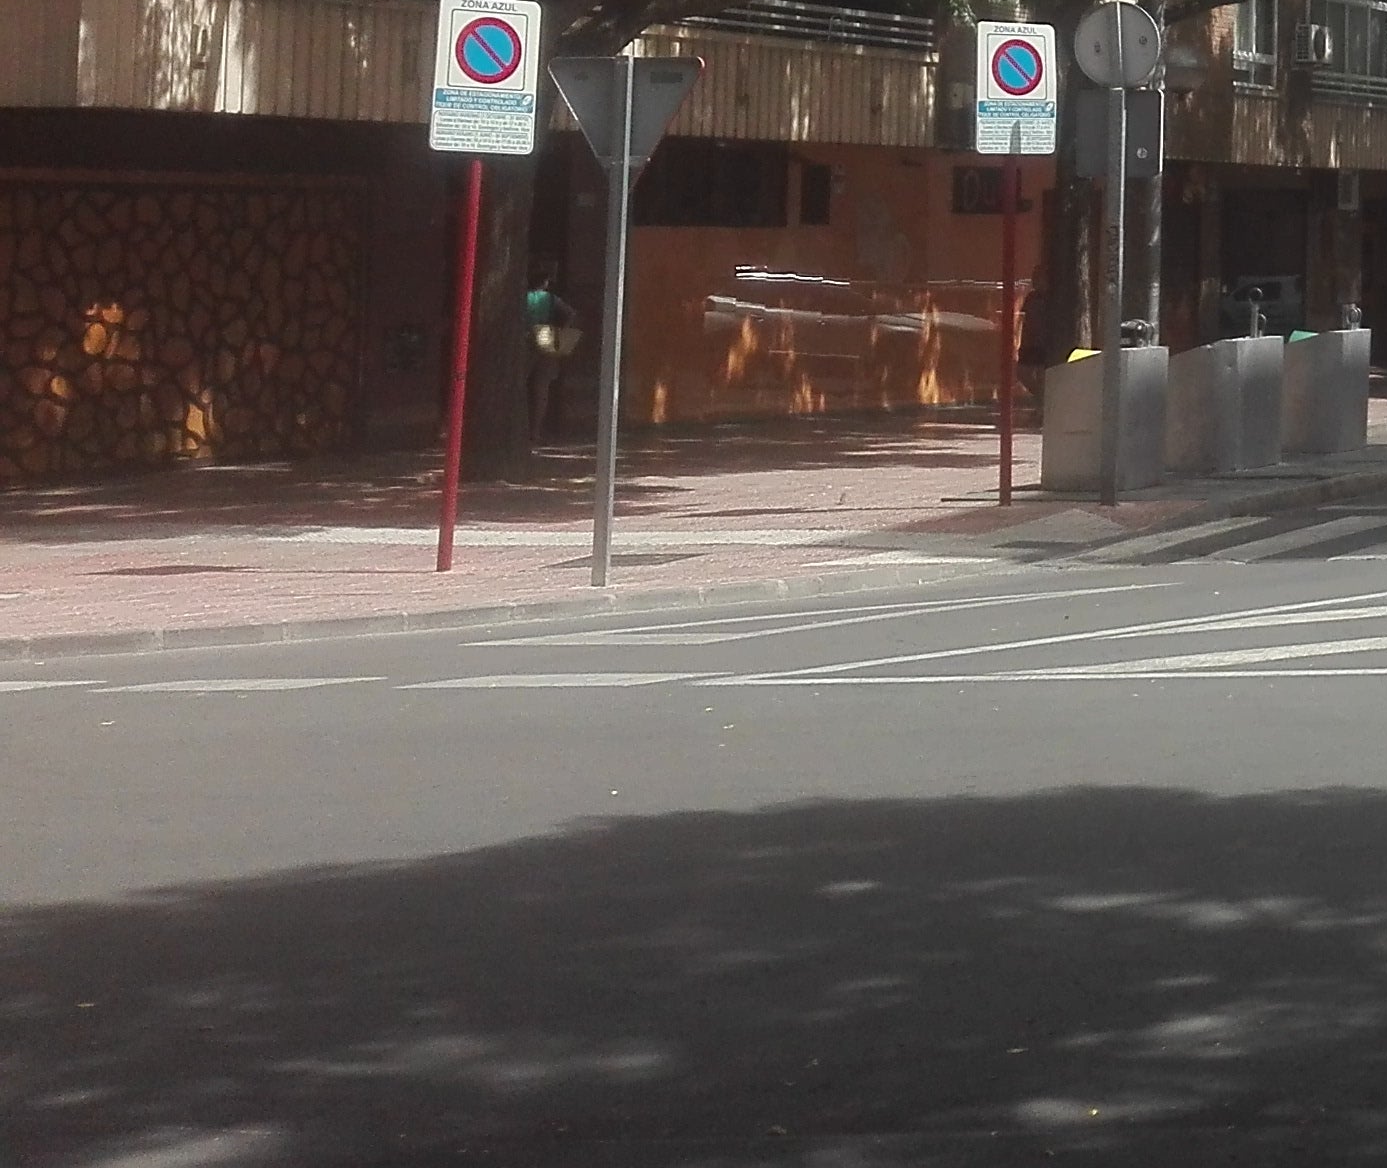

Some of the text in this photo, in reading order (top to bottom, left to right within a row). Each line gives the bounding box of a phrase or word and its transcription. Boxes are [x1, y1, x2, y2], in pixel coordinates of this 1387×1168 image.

[491, 2, 517, 12] AZUL
[993, 25, 1037, 34] ZONA AZUL
